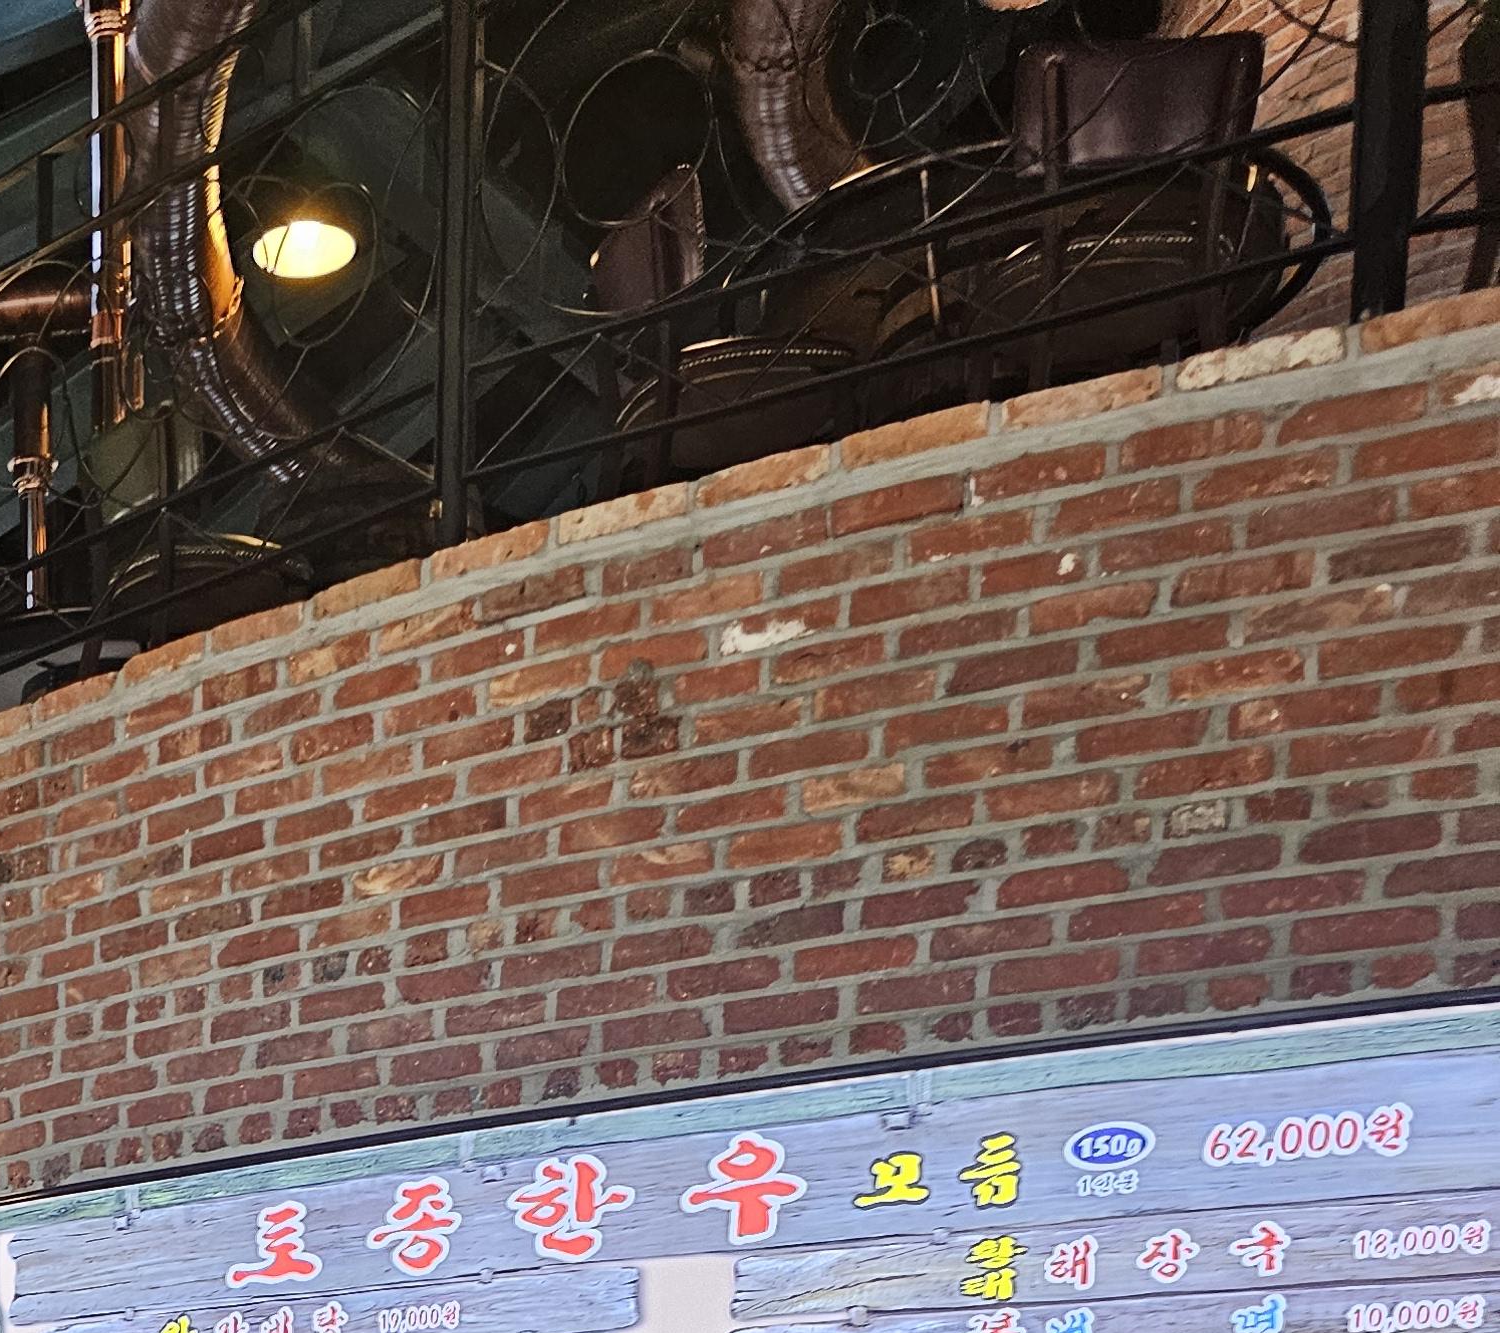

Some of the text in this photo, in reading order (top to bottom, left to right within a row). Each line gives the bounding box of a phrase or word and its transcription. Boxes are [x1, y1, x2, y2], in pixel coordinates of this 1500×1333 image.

[1077, 1134, 1144, 1160] 150g
[1207, 1106, 1406, 1162] 62,000원
[227, 1134, 803, 1287] 토종한우
[1048, 1225, 1284, 1286] 해장국
[381, 1303, 458, 1331] 19,000원
[1352, 1299, 1479, 1331] 10,000원
